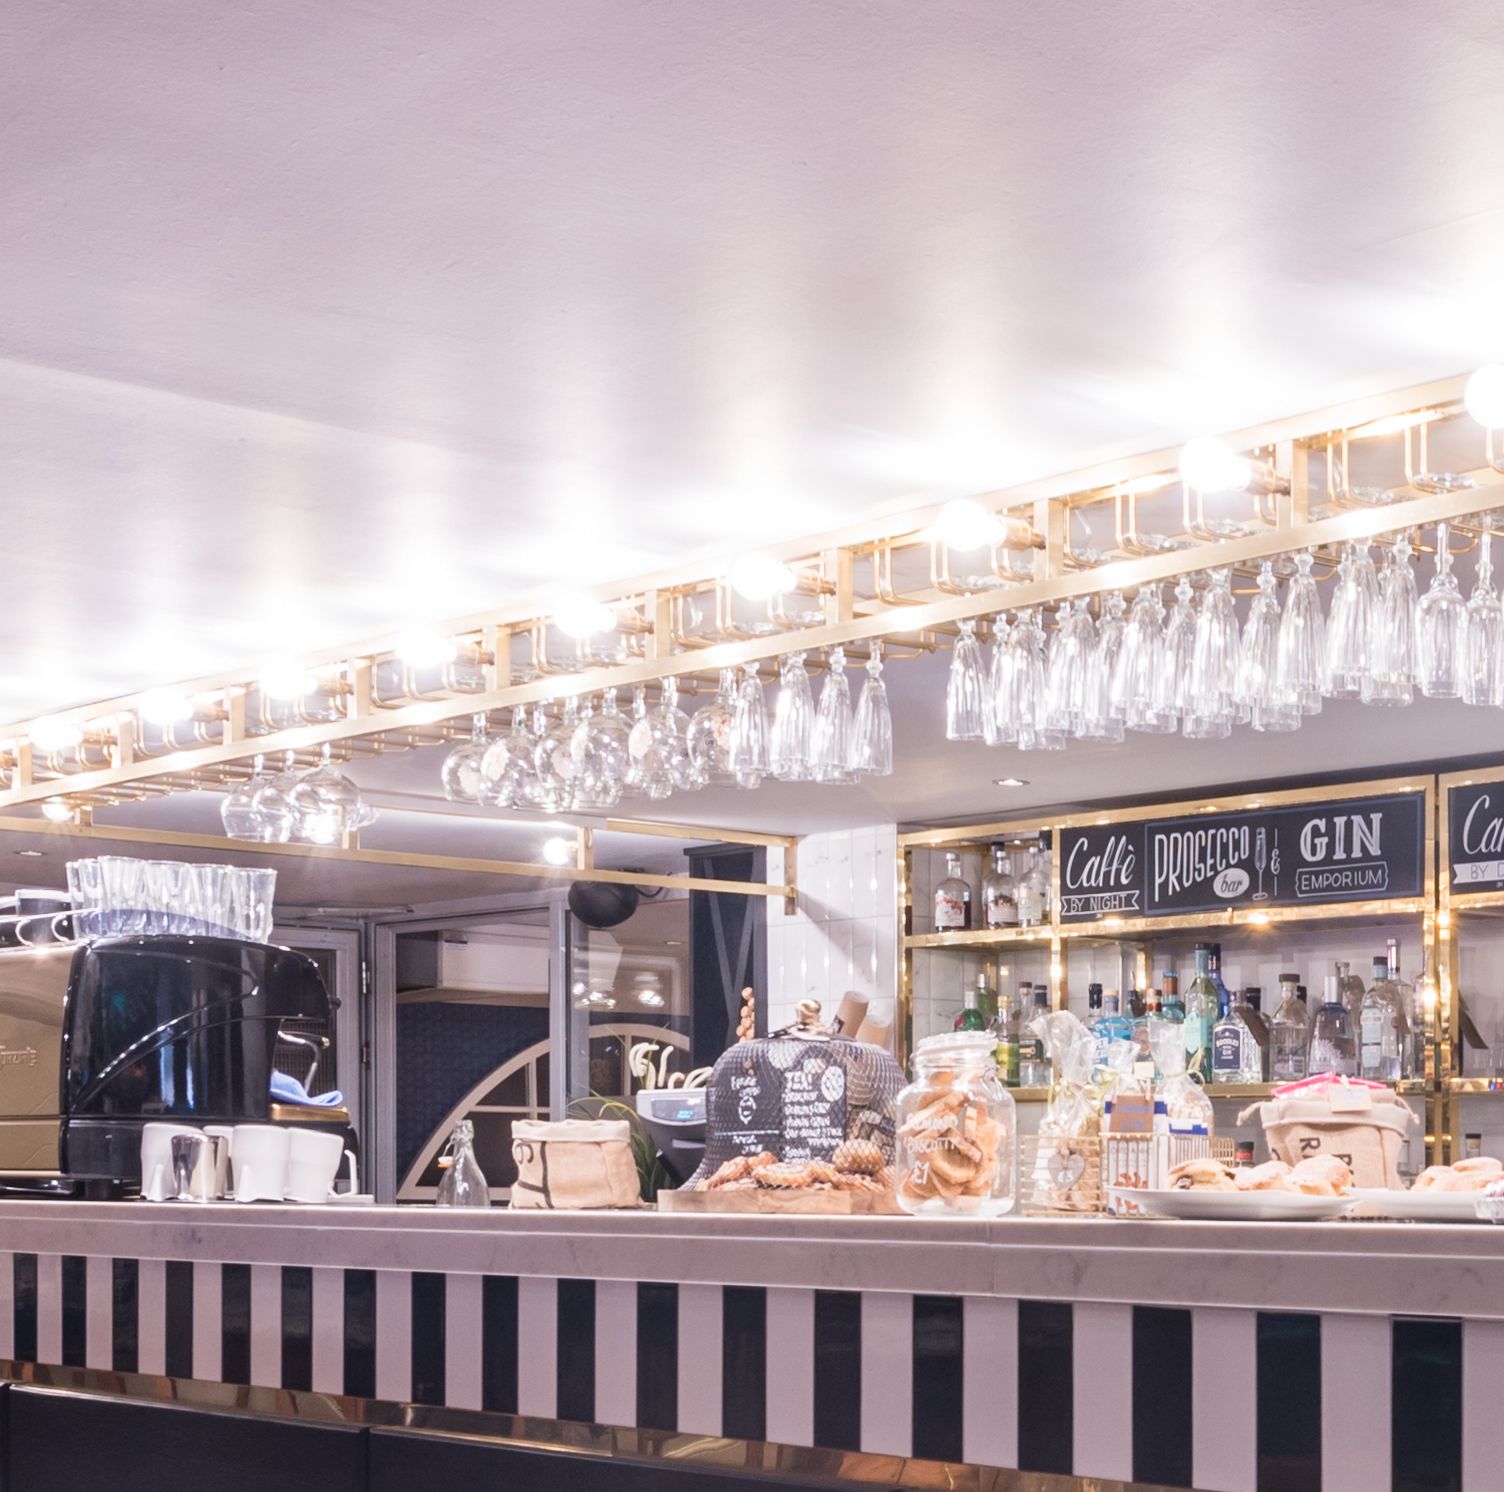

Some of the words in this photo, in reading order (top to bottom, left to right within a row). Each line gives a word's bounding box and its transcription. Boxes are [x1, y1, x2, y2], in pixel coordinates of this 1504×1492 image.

[1300, 812, 1383, 862] GIN
[1066, 834, 1136, 890] Caffè
[1155, 826, 1249, 902] PROSECCO
[1470, 864, 1489, 880] BY
[1220, 874, 1243, 894] bar
[1301, 868, 1383, 892] EMPORIUM
[1070, 898, 1087, 913] BY
[1090, 894, 1128, 912] NIGHT
